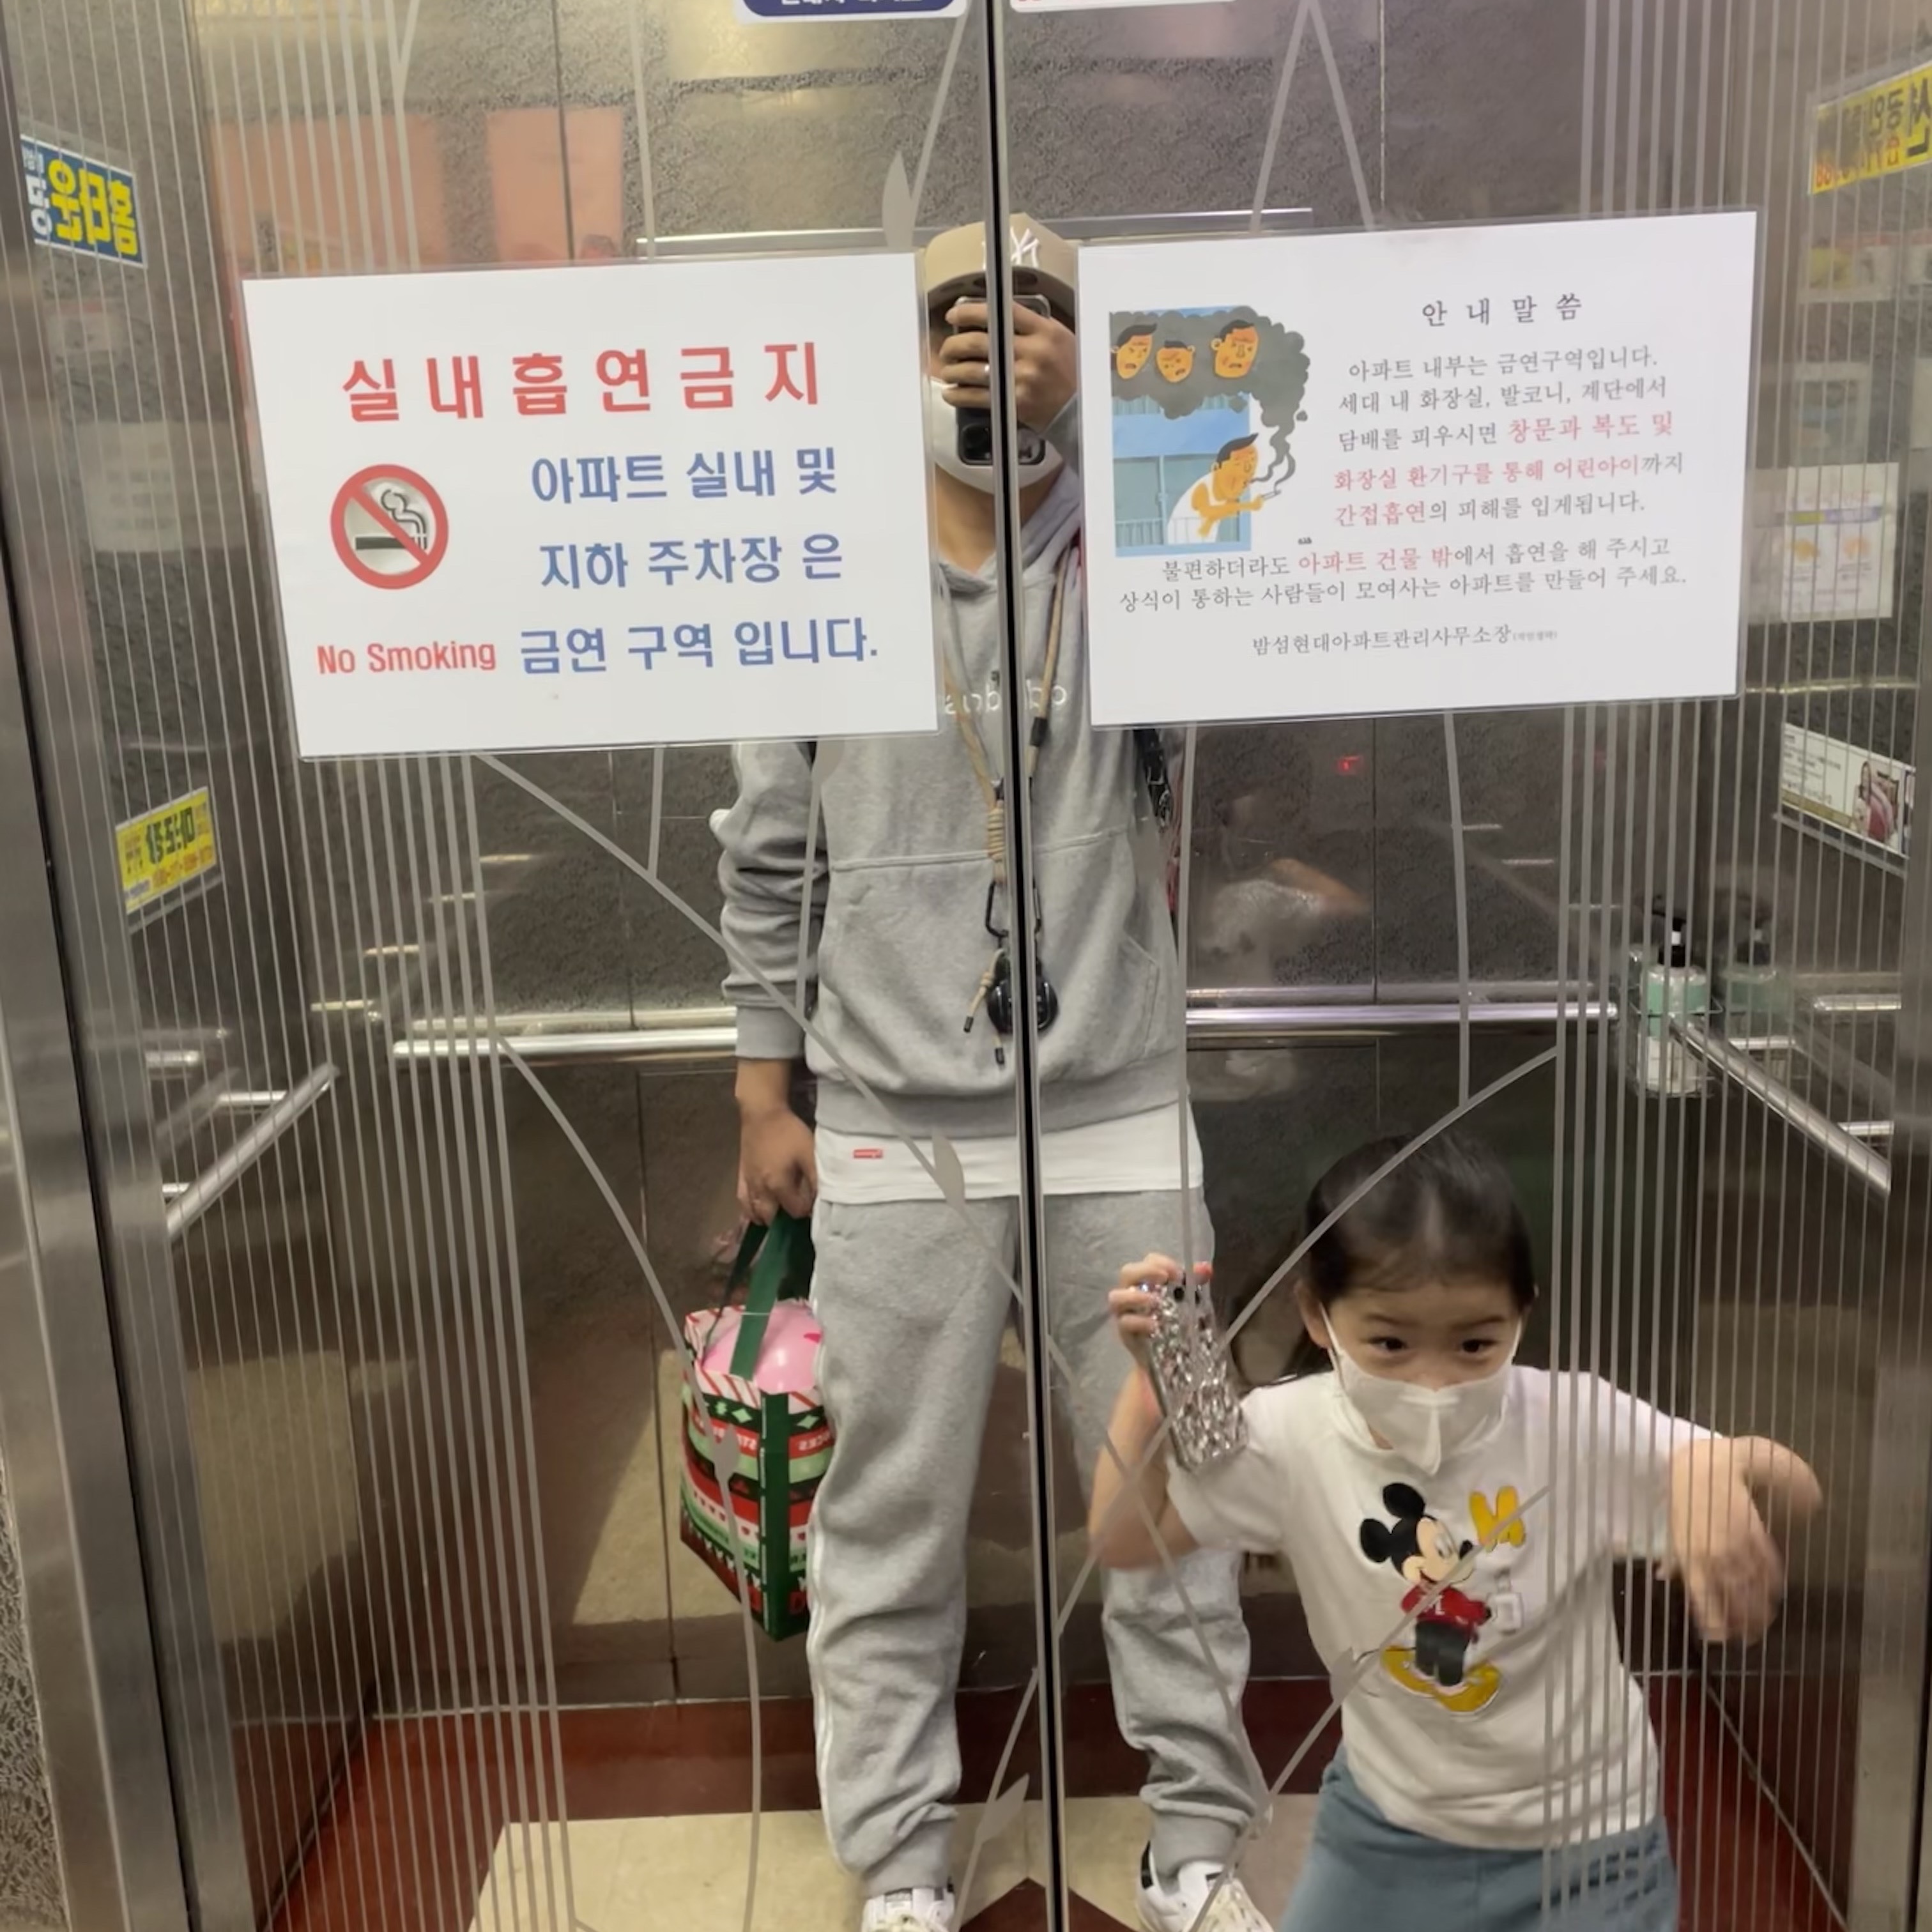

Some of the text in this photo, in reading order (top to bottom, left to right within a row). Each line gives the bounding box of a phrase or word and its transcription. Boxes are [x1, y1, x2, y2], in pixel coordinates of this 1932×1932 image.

[1349, 345, 1657, 382] 아파트 내부는 금연구역입니다.
[1340, 376, 1665, 415] 세대 내 화장실, 발코니, 계단에서
[1339, 411, 1671, 452] 담배를 피우시면 창문과 복도 및
[532, 447, 837, 504] 아파트 실내 및
[1335, 452, 1682, 491] 화장실 환기구를 통해 어린아이까지
[1337, 491, 1644, 526] 간접흡연의 피해를 입게됩니다.
[539, 533, 842, 589] 지하 주차장 은
[1163, 537, 1669, 581] 불편하더라도 아파트 건물 밖에서 흡연을 해 주시고
[1121, 565, 1685, 613] 상식이 통하는 사람들이 모여사는 아파트를 만들어 주세요.
[317, 640, 496, 675] No Smoking
[521, 617, 877, 674] 금연 구역 입니다.
